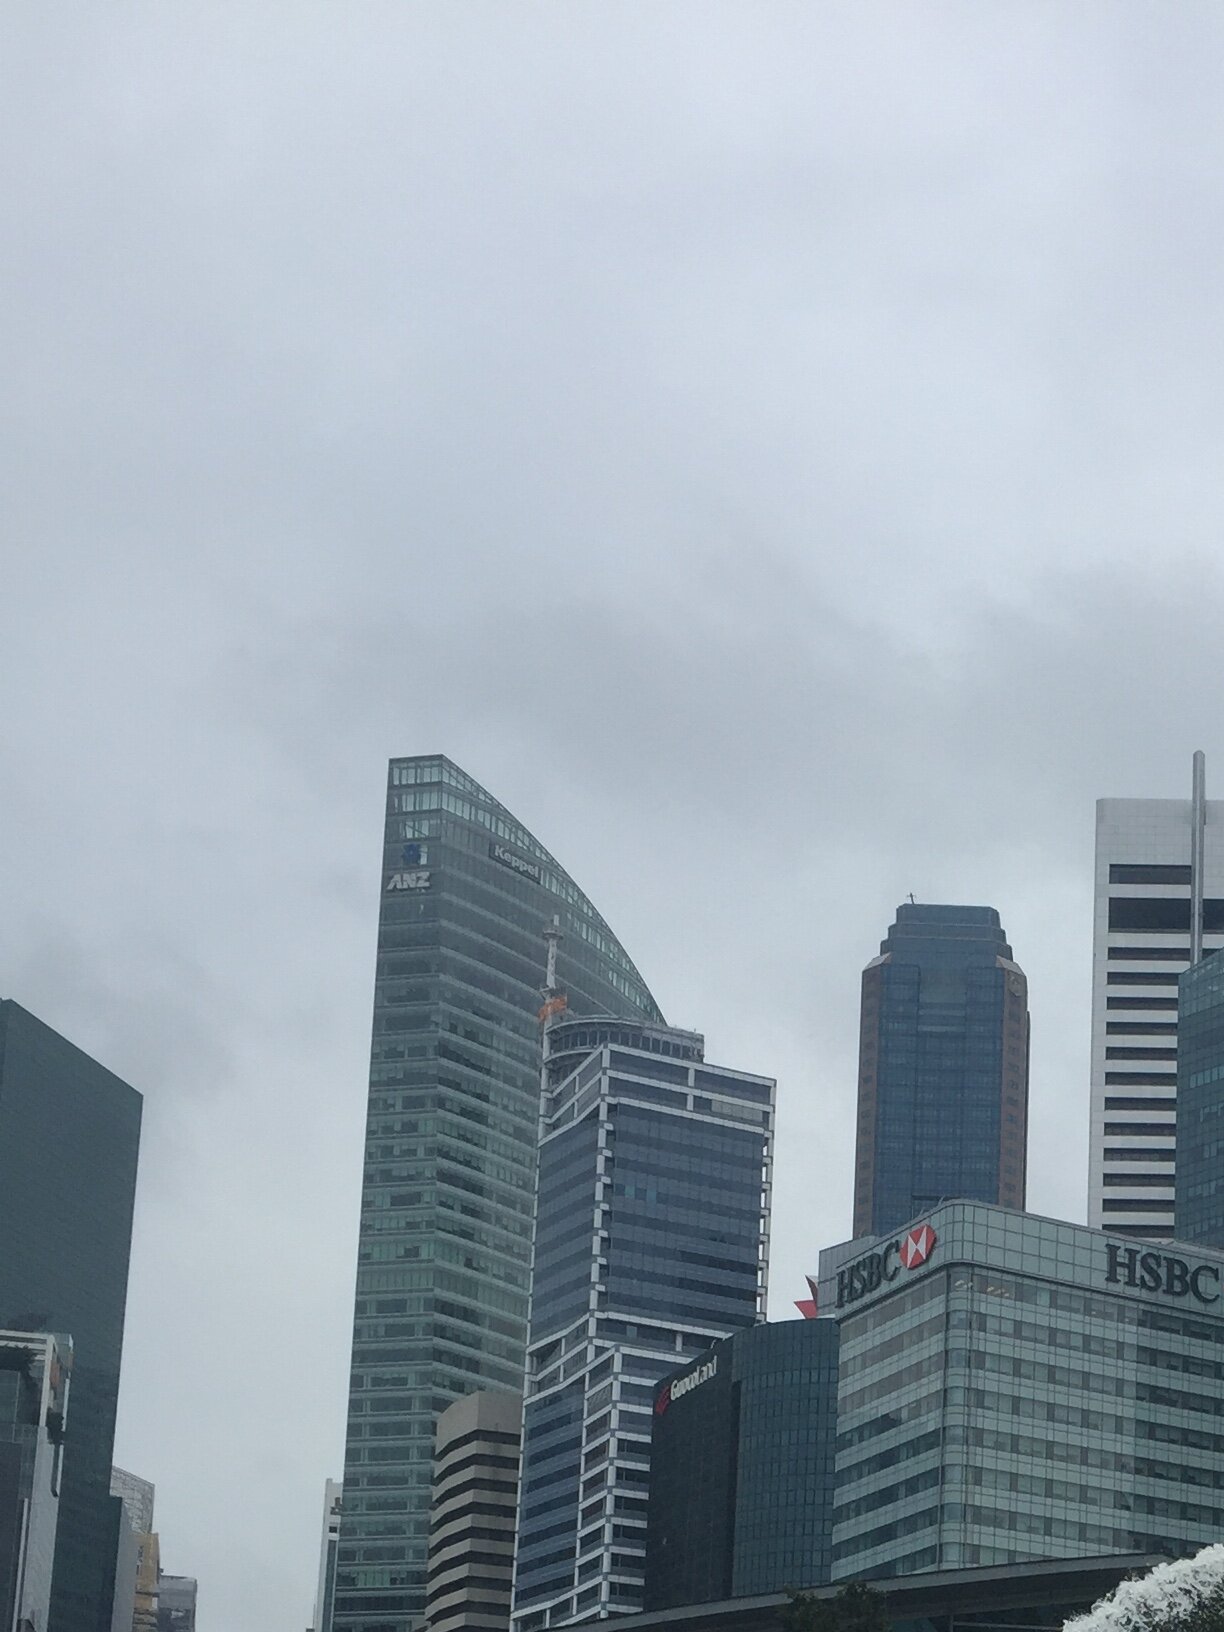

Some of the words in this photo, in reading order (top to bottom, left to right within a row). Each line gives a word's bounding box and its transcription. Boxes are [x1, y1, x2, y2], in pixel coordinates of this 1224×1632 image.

[386, 871, 431, 890] ANZ
[494, 845, 540, 878] Keppel
[835, 1239, 901, 1308] HSBC
[1105, 1243, 1220, 1303] HSBC
